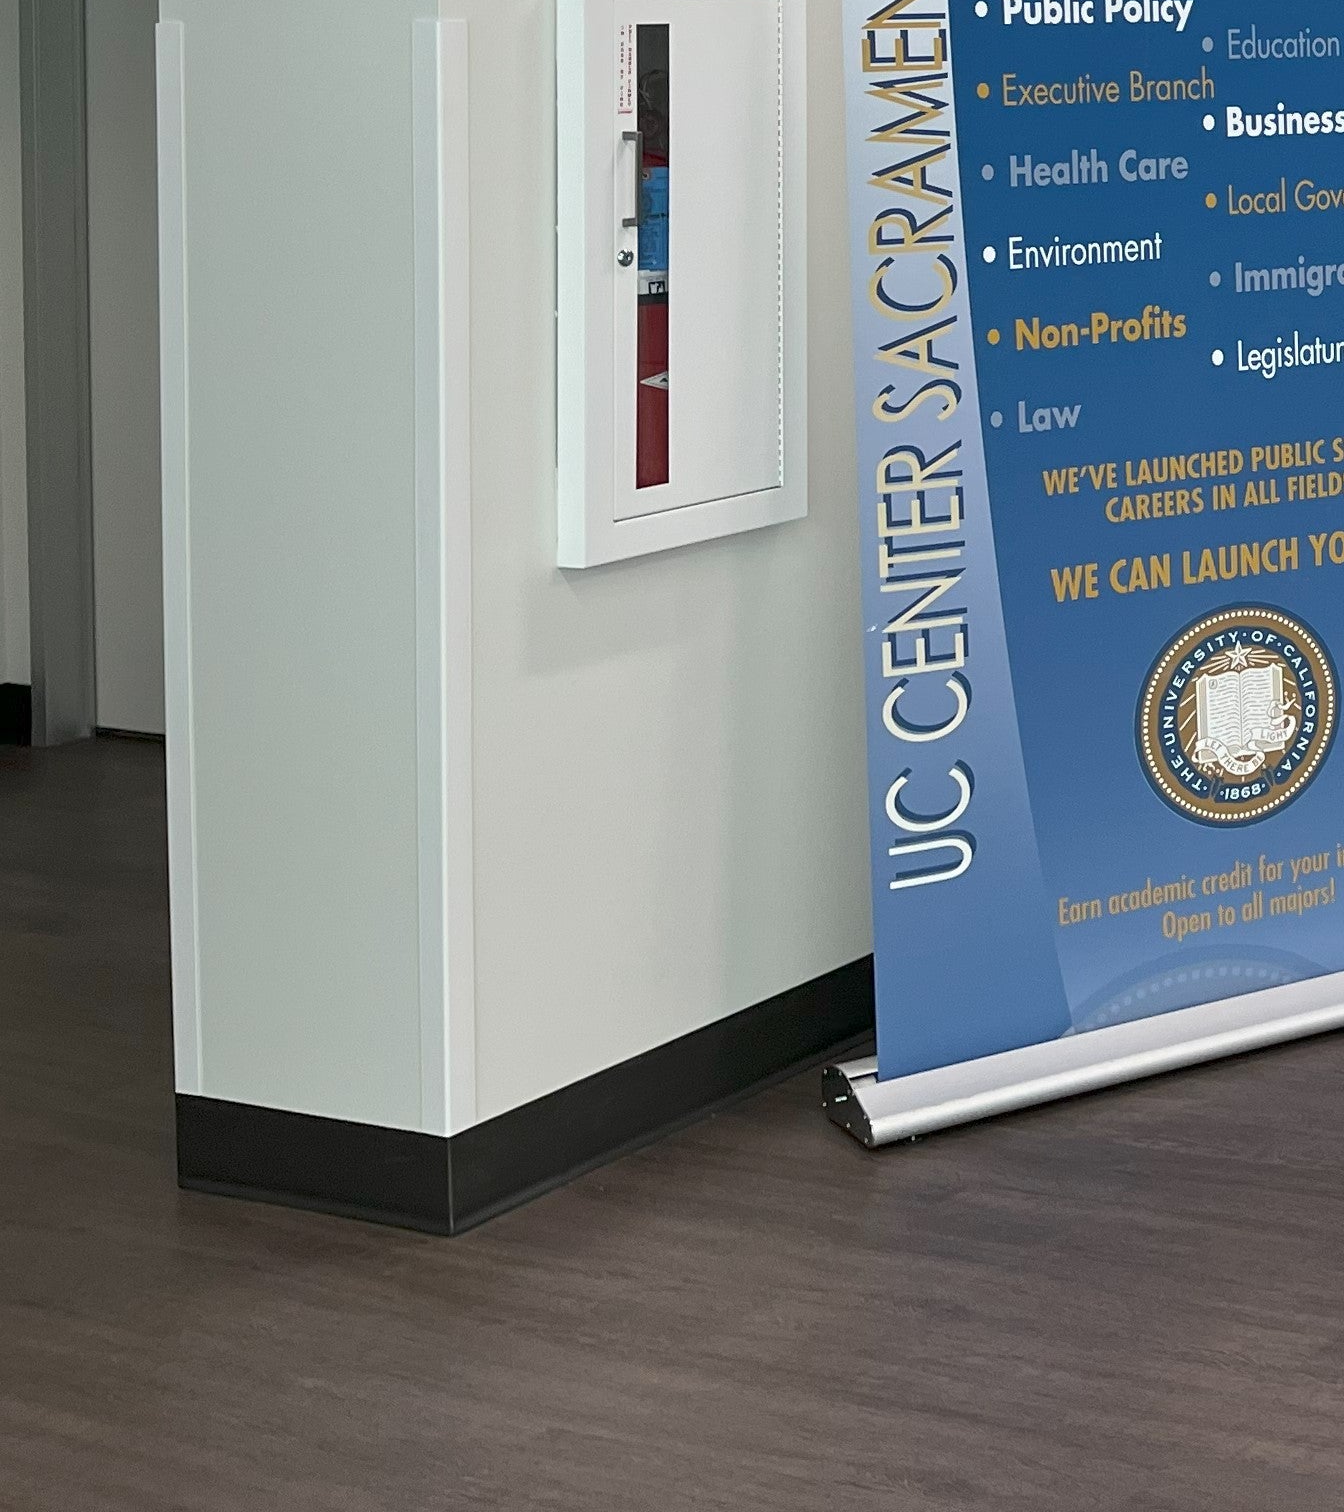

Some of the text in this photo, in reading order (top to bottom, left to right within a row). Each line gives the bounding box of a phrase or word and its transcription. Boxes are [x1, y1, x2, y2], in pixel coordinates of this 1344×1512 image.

[1227, 23, 1341, 60] Education
[1002, 65, 1216, 107] Executive Branch
[1009, 148, 1190, 188] Health Care
[1228, 176, 1287, 217] Local
[1008, 232, 1163, 270] Environment
[1014, 304, 1188, 351] Non-Profits
[1017, 400, 1082, 433] Law
[1042, 462, 1118, 496] WE'VE
[1124, 448, 1244, 487] LAUNCHED
[1250, 438, 1326, 472] PUBLIC
[1104, 486, 1205, 523] CAREERS
[1212, 482, 1237, 511] IN
[1243, 478, 1281, 507] ALL
[876, 439, 974, 743] CENTER
[1050, 562, 1100, 603] WE
[1108, 552, 1172, 595] CAN
[1181, 536, 1299, 585] LAUNCH
[1162, 630, 1318, 792] THE UNIVERSITY OF CALIFORNIA
[1204, 737, 1222, 752] LET
[1218, 749, 1245, 773] THERE
[1260, 727, 1289, 740] LIGHT
[1224, 783, 1261, 801] 1868
[885, 758, 977, 890] UC
[1058, 896, 1103, 926] Earn
[1108, 874, 1197, 916] academic
[1201, 858, 1253, 896] credit
[1258, 854, 1284, 884] for
[1290, 851, 1331, 884] your
[1161, 877, 1336, 942] Open to all majors!
